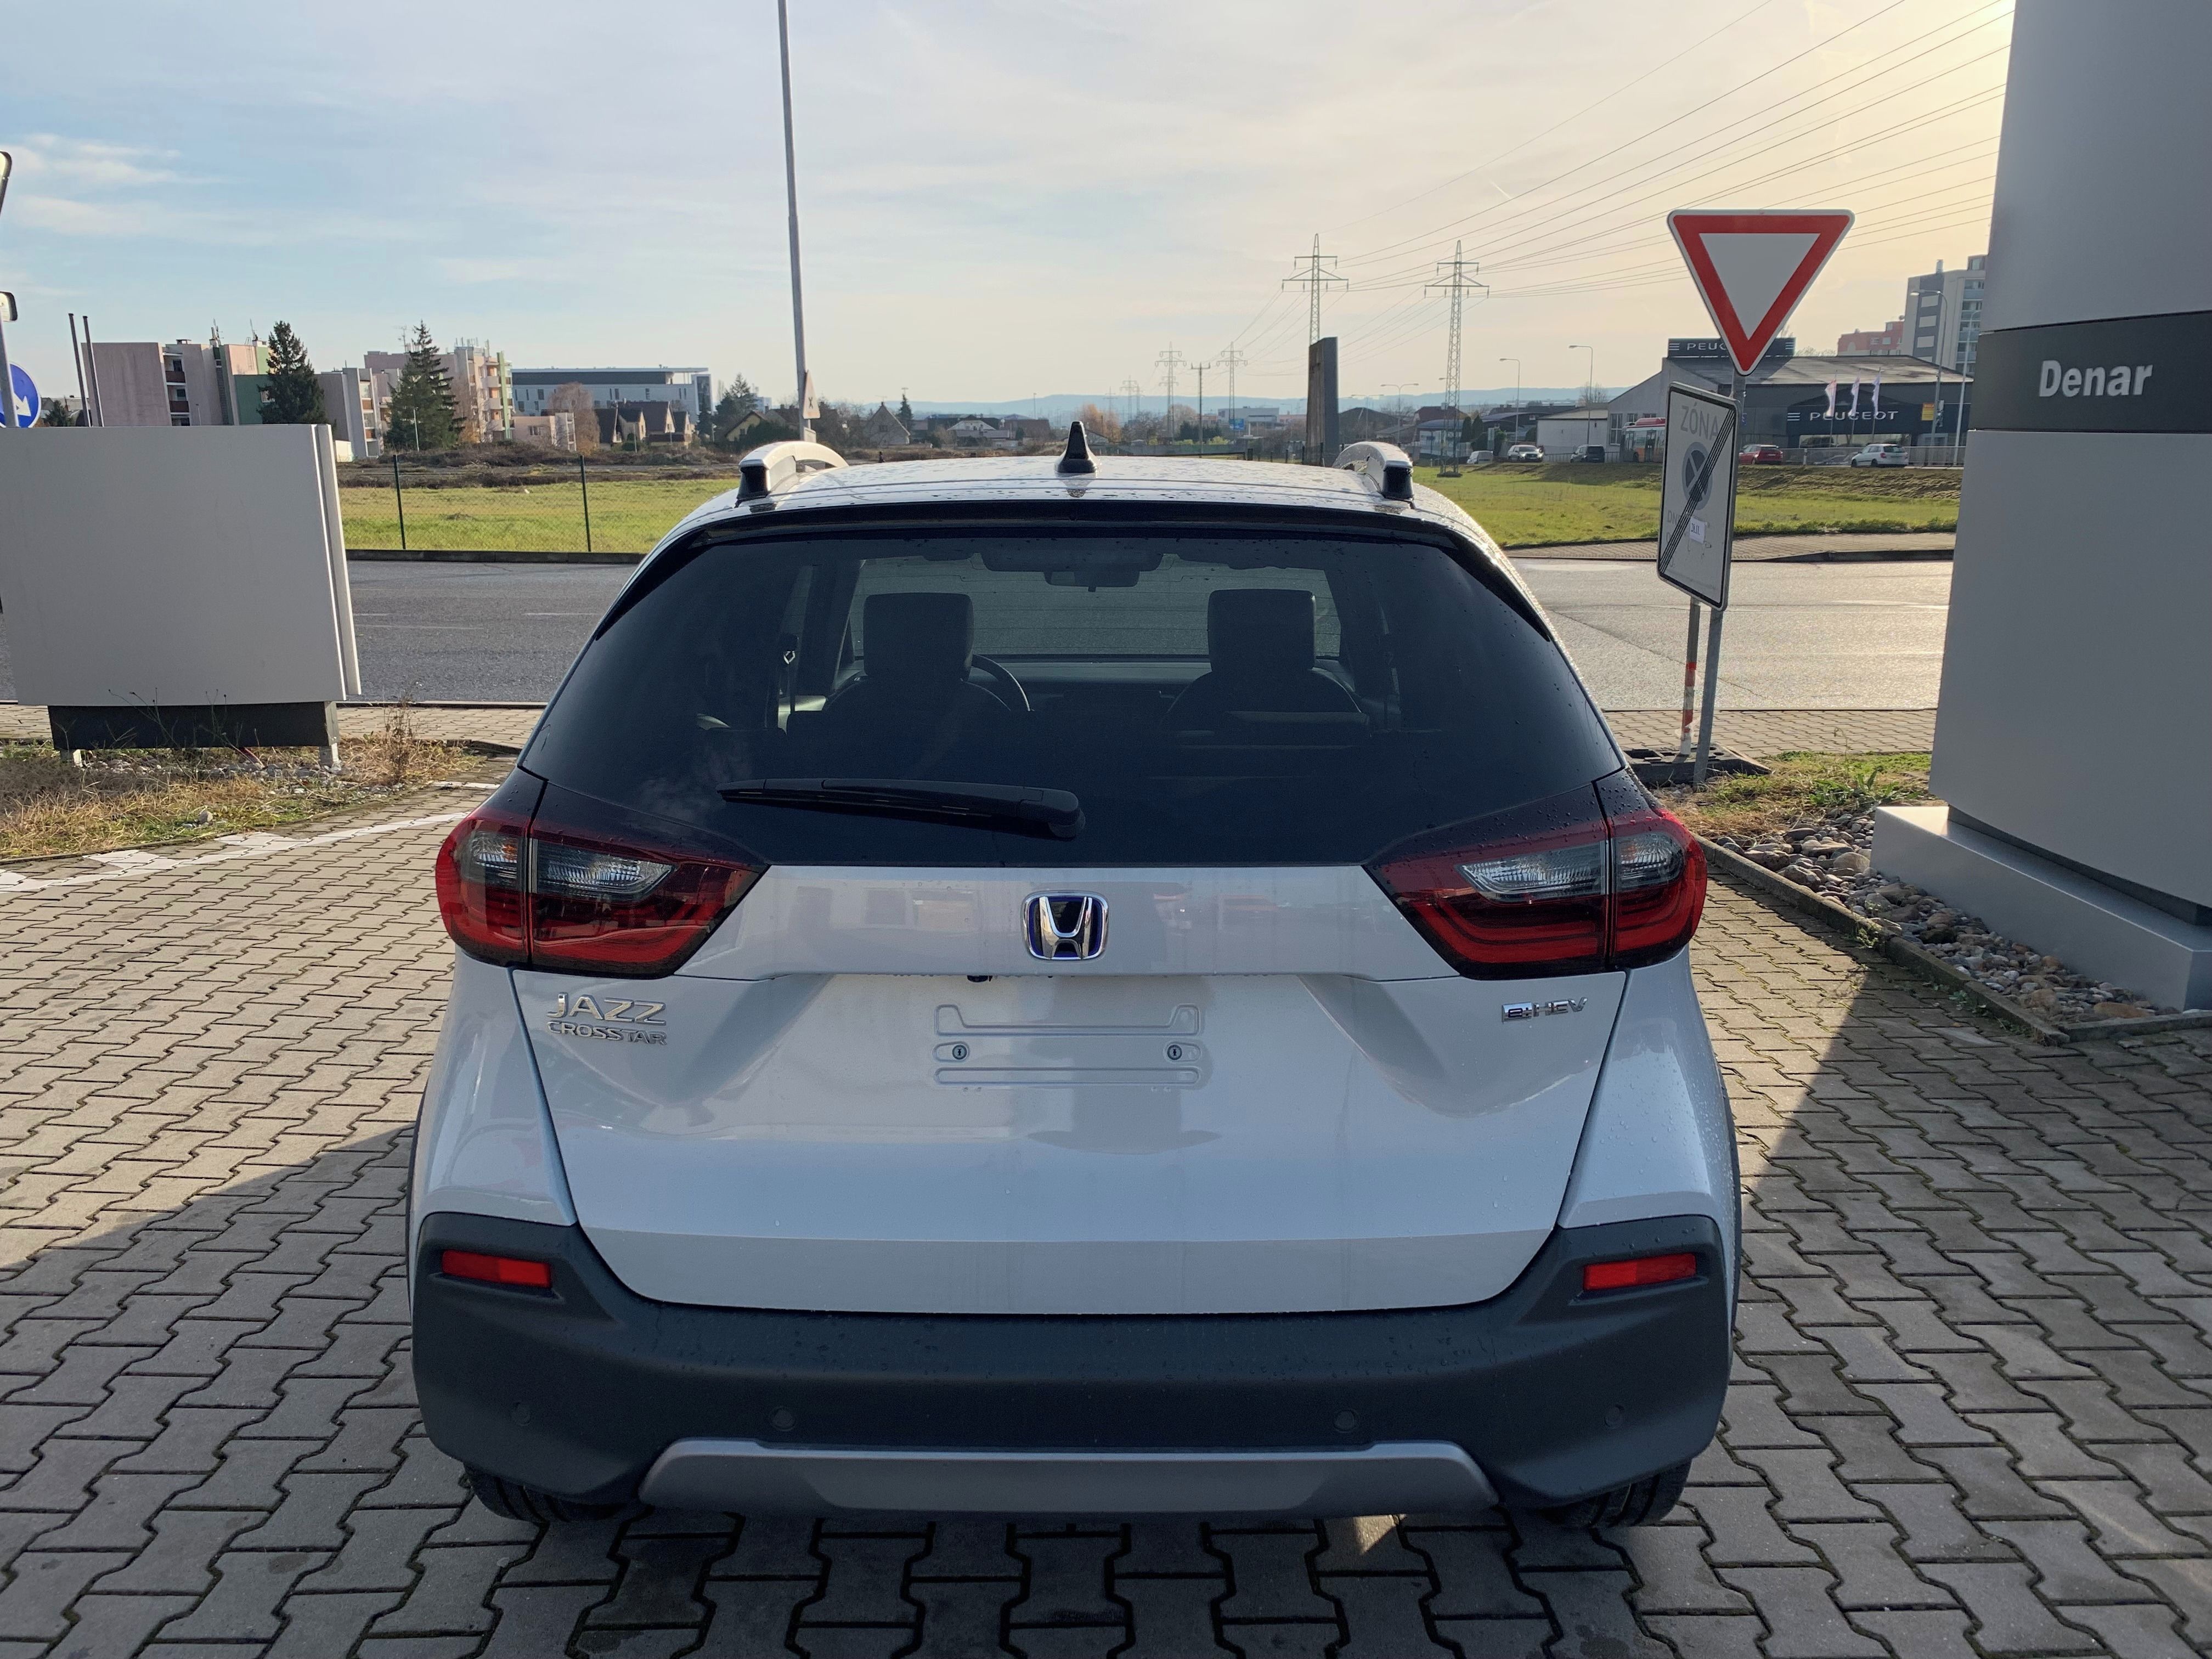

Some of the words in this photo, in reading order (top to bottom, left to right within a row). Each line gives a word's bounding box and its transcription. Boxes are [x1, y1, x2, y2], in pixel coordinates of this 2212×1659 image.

[2039, 359, 2153, 398] Denar
[1680, 402, 1719, 440] ZÓNA
[1810, 411, 1899, 421] PEUGEOT
[546, 991, 667, 1025] JAZZ
[546, 1020, 667, 1045] CROSSTAR
